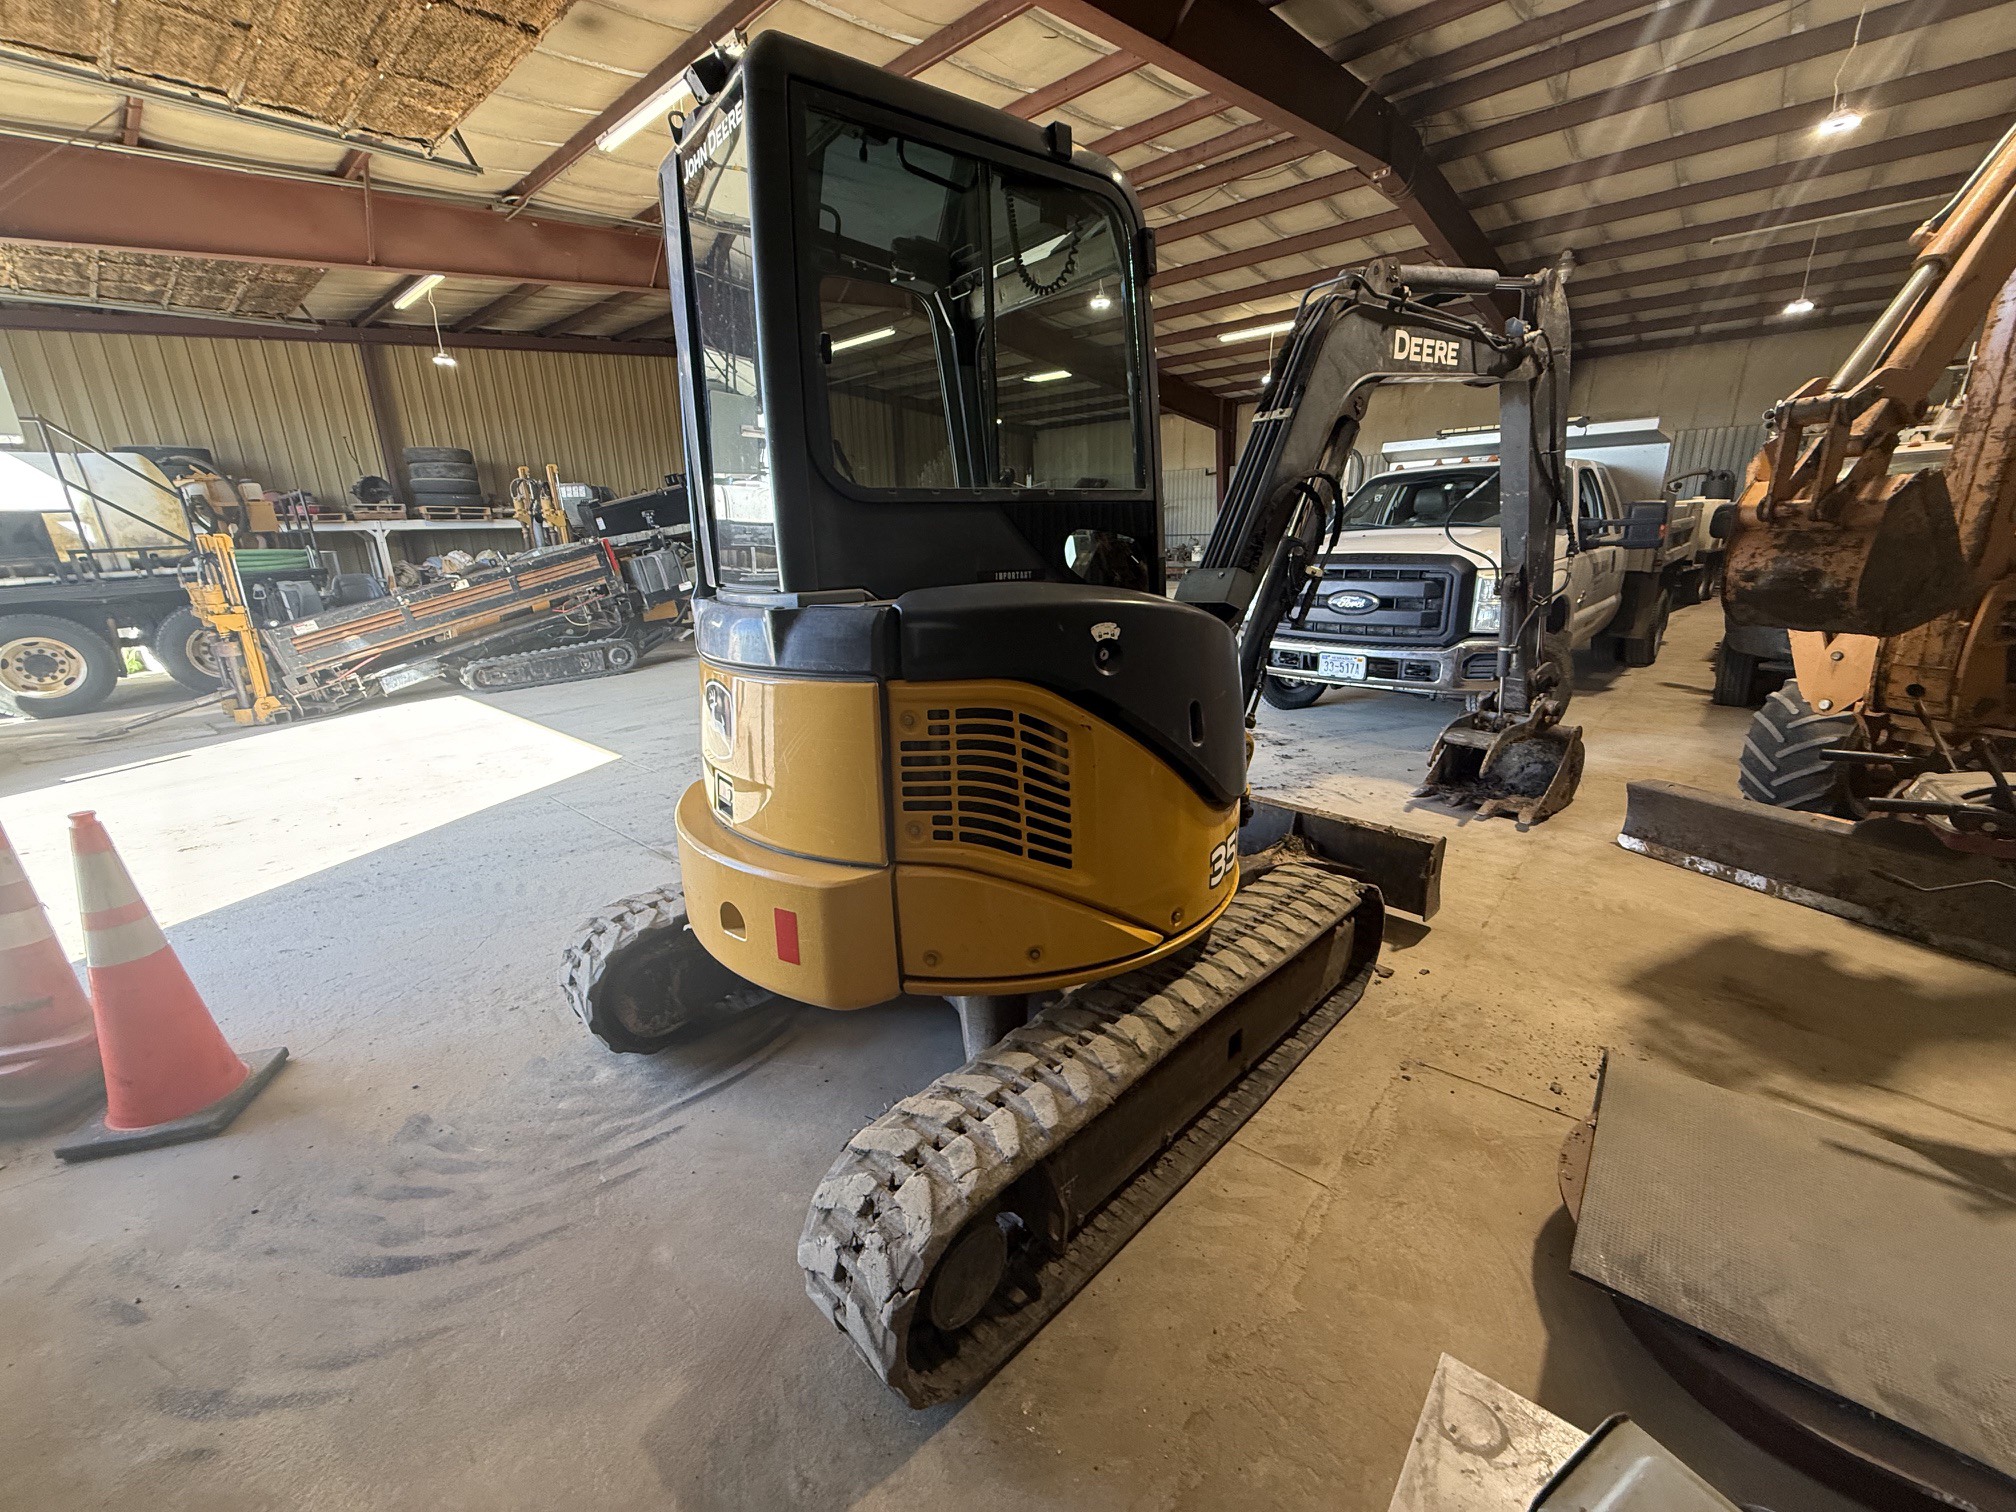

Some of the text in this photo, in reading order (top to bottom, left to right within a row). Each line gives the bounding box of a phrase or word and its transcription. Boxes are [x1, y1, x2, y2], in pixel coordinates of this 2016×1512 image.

[683, 99, 744, 185] JOHN DEERE
[1393, 329, 1460, 366] DEERE
[995, 570, 1032, 580] IMPORTANT
[1329, 595, 1366, 608] Ford
[1324, 661, 1360, 675] 33-517A
[1208, 826, 1237, 890] 35
